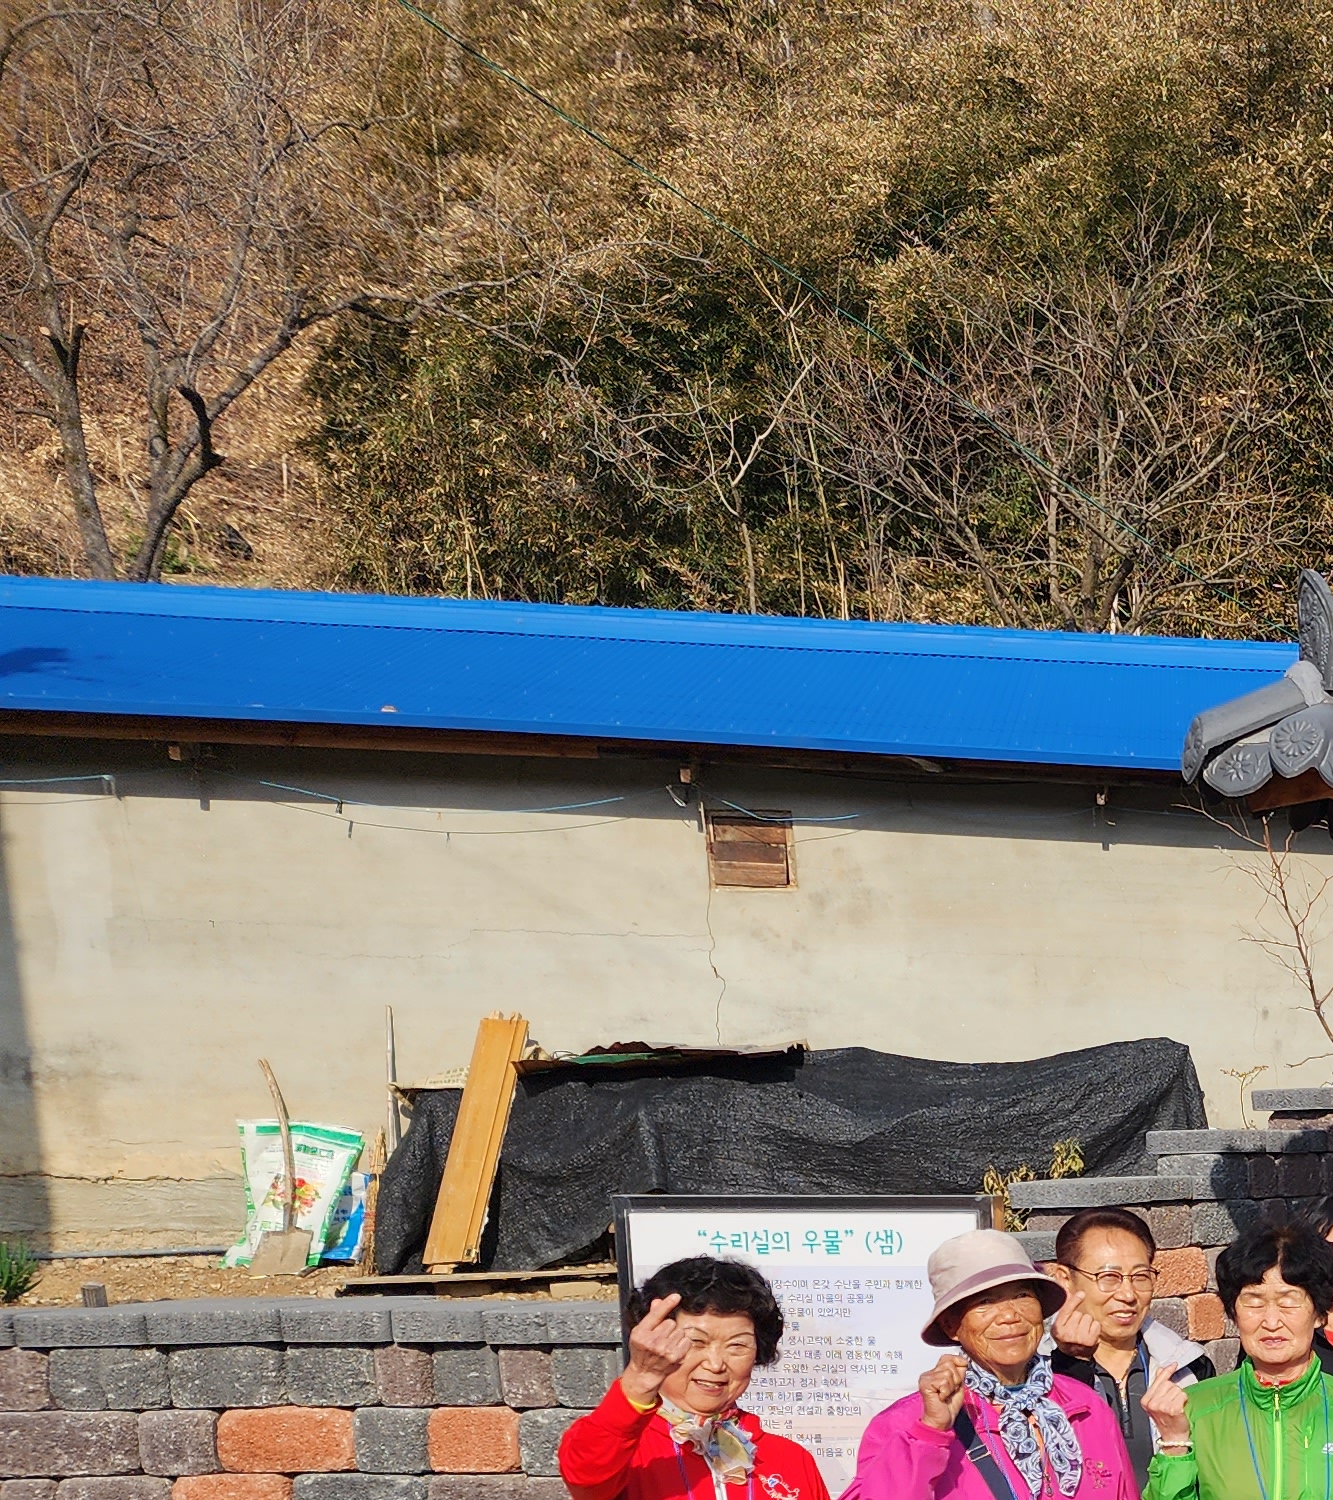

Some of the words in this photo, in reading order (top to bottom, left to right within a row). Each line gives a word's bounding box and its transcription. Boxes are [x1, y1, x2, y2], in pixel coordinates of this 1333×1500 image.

[864, 1230, 903, 1255] (샘)
[865, 1280, 891, 1290] 주민과
[787, 1293, 813, 1304] 수리실
[816, 1293, 843, 1304] 마을의
[783, 1350, 801, 1360] 조선
[783, 1364, 809, 1374] 유일한
[812, 1364, 847, 1374] 수리실의
[850, 1364, 877, 1374] 역사의
[751, 1378, 796, 1388] 보존하고자
[807, 1391, 850, 1402] 기원하면서
[797, 1405, 823, 1416] 전설과
